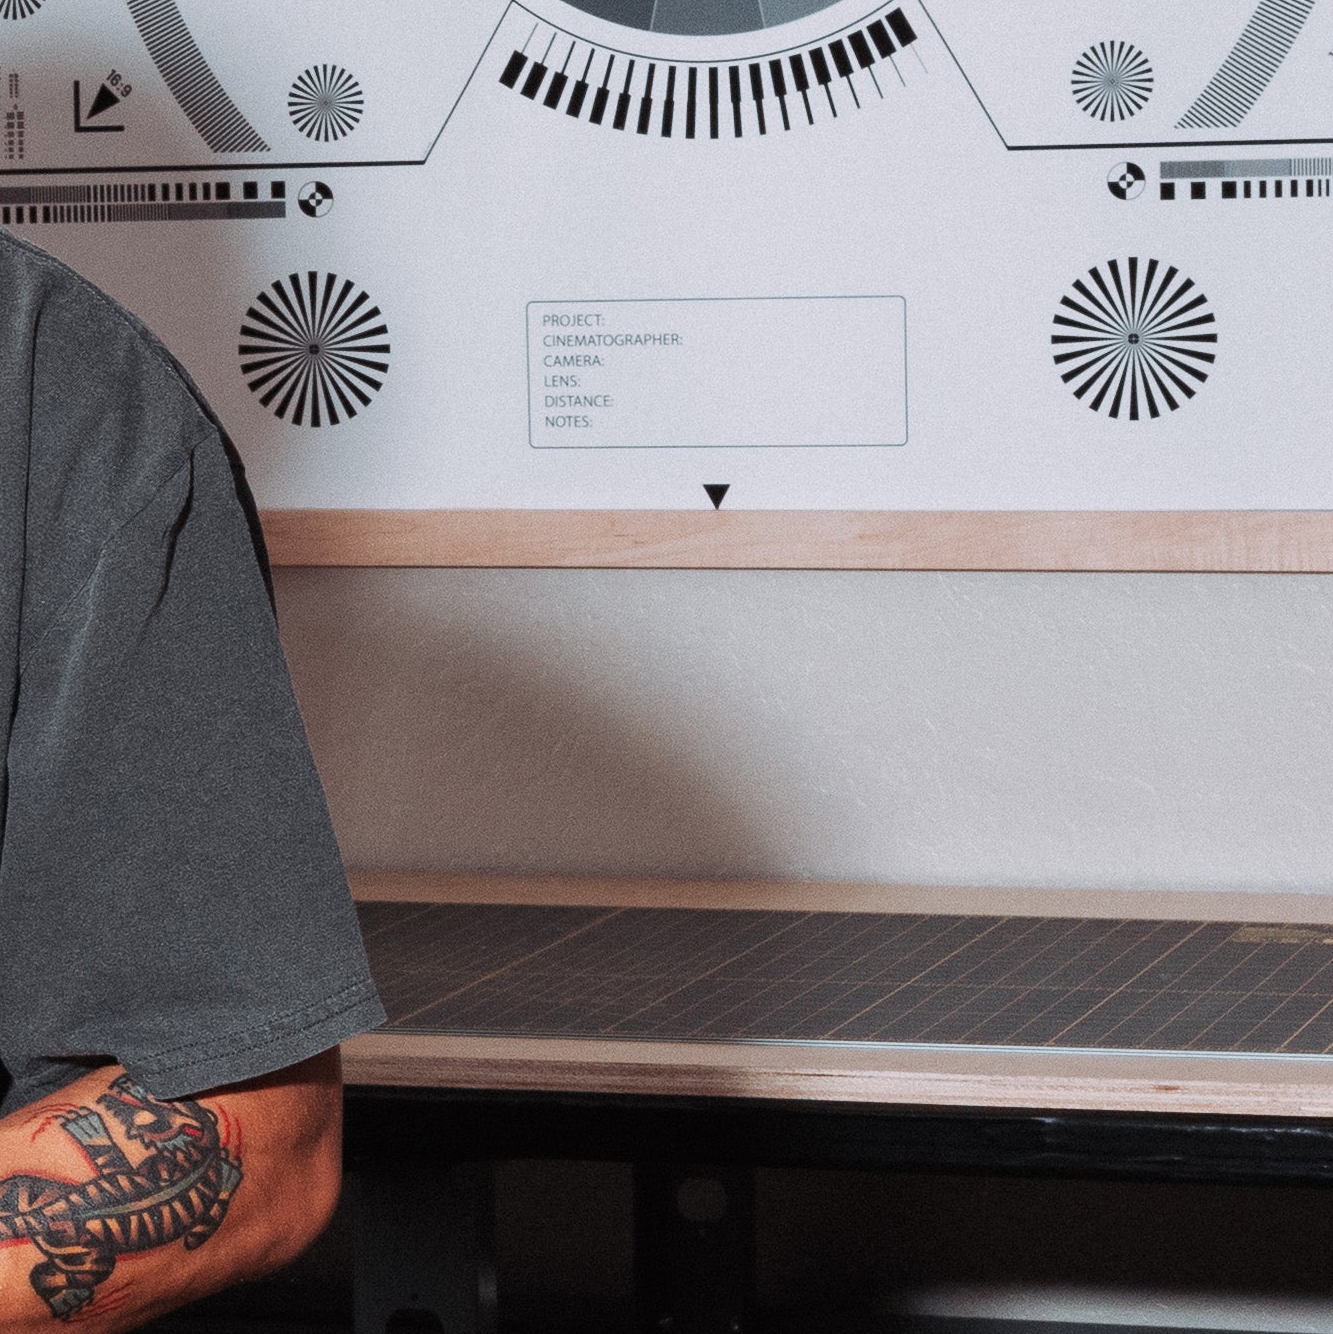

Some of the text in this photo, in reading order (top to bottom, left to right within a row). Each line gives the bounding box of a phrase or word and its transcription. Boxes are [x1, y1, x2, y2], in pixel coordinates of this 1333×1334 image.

[106, 69, 133, 98] 16:9
[542, 314, 605, 327] PROJECT:
[543, 333, 683, 348] CINEMATOGRAPHER:
[543, 355, 605, 368] CAMERA:
[544, 375, 581, 387] LENS:
[545, 395, 614, 407] DISTANCE:
[545, 415, 593, 428] NOTES:
